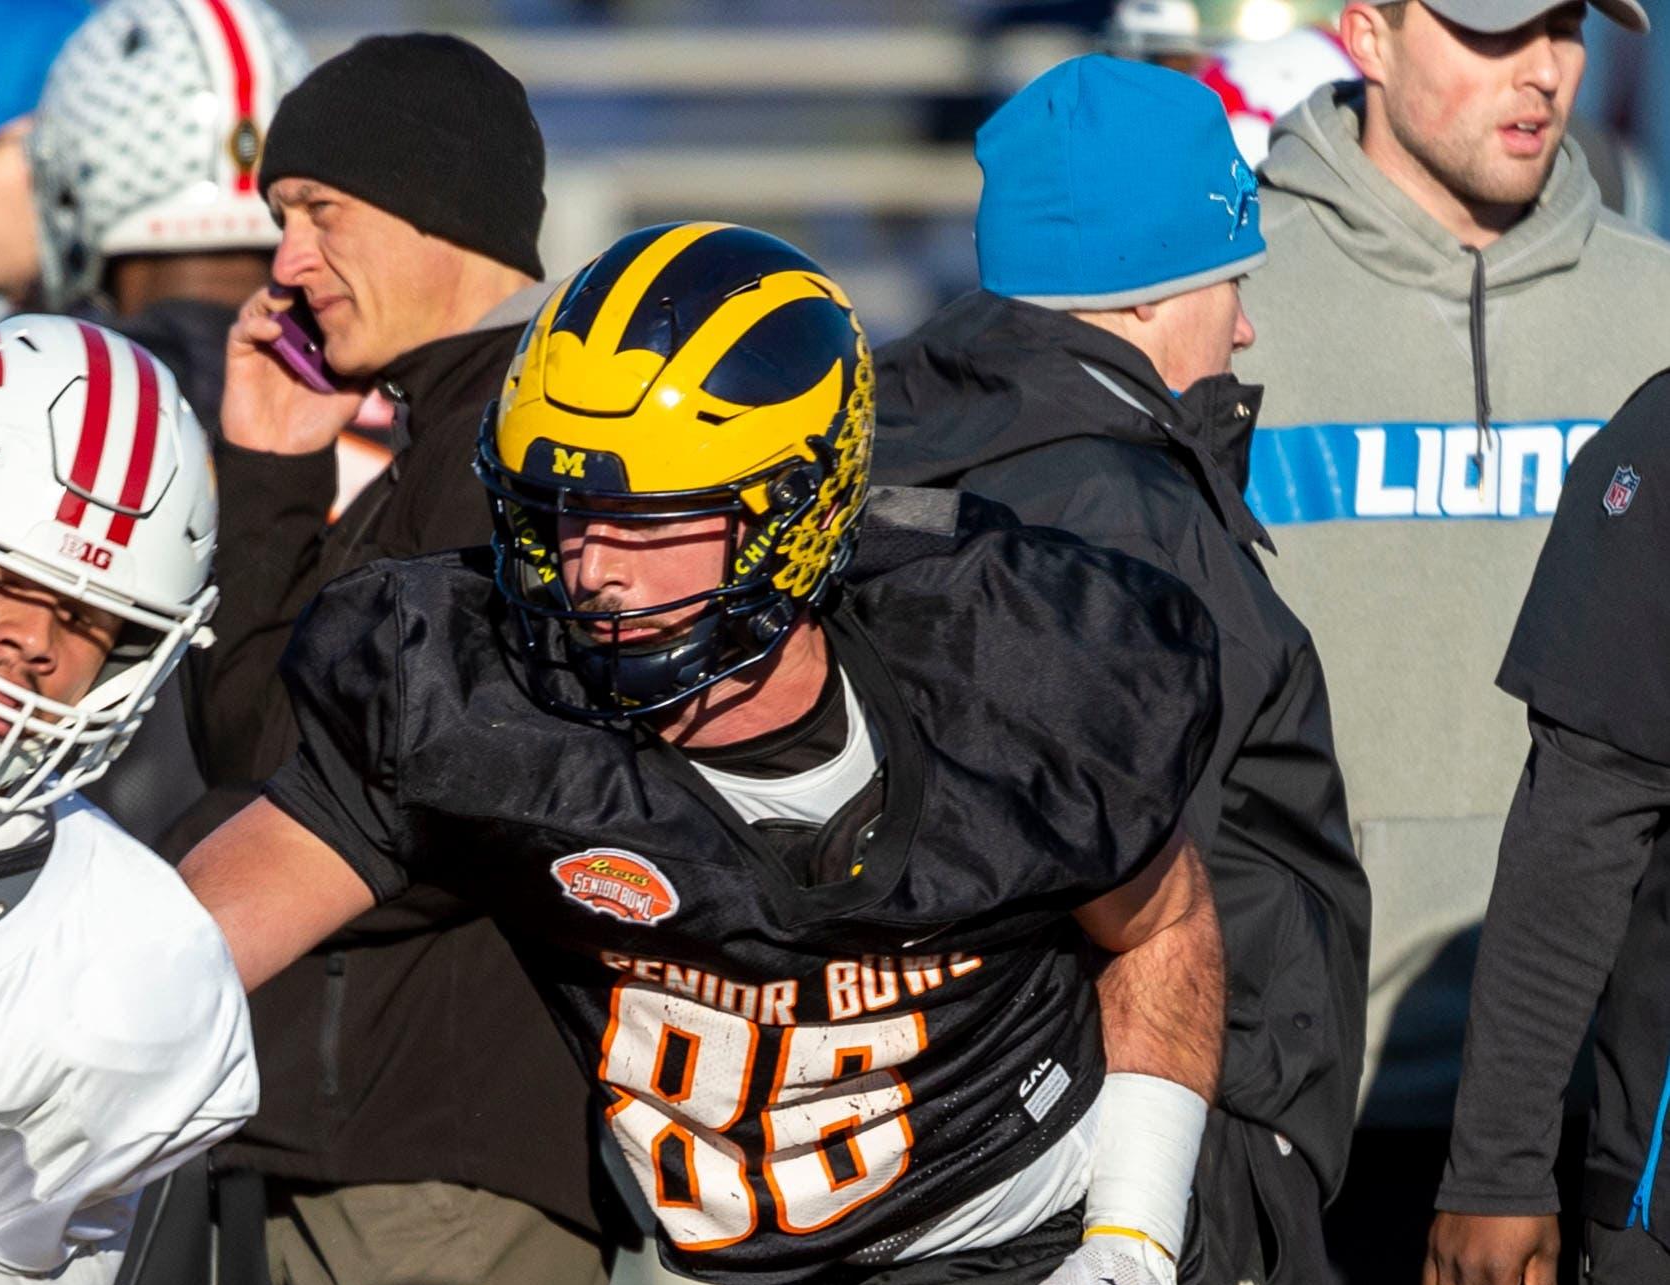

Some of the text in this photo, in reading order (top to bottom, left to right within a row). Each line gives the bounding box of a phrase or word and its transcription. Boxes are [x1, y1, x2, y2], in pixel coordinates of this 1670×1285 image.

[552, 447, 586, 479] M
[571, 872, 655, 920] SENIOR BOWL
